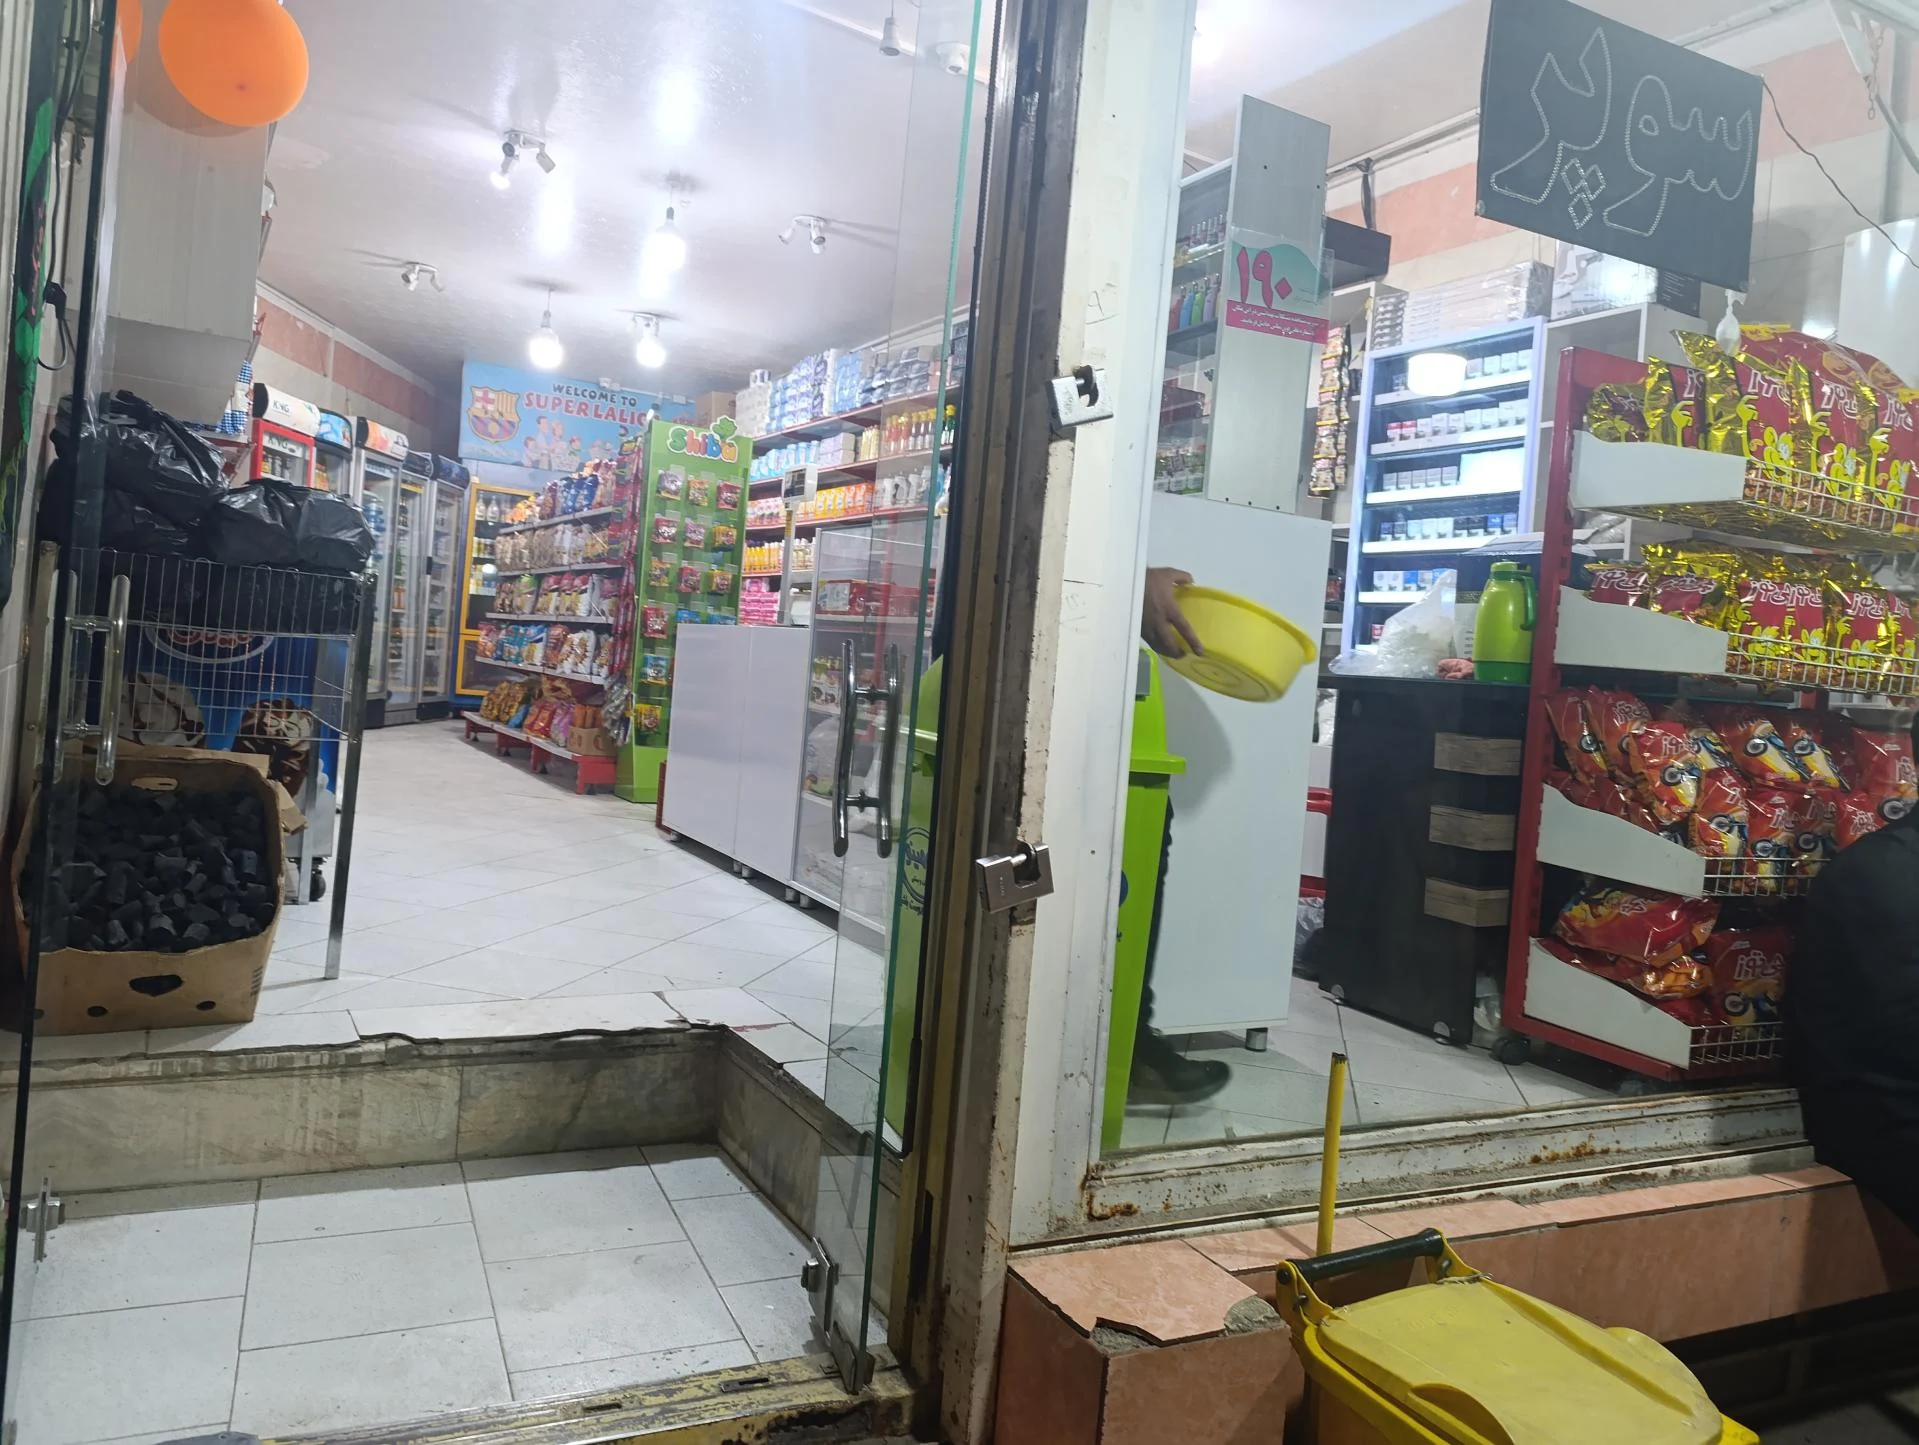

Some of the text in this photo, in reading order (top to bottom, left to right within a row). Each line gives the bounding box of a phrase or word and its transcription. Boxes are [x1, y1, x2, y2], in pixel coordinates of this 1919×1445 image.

[1236, 246, 1293, 310] ۱۹۰
[524, 392, 589, 418] SUPER
[552, 383, 637, 408] WELCOME TO
